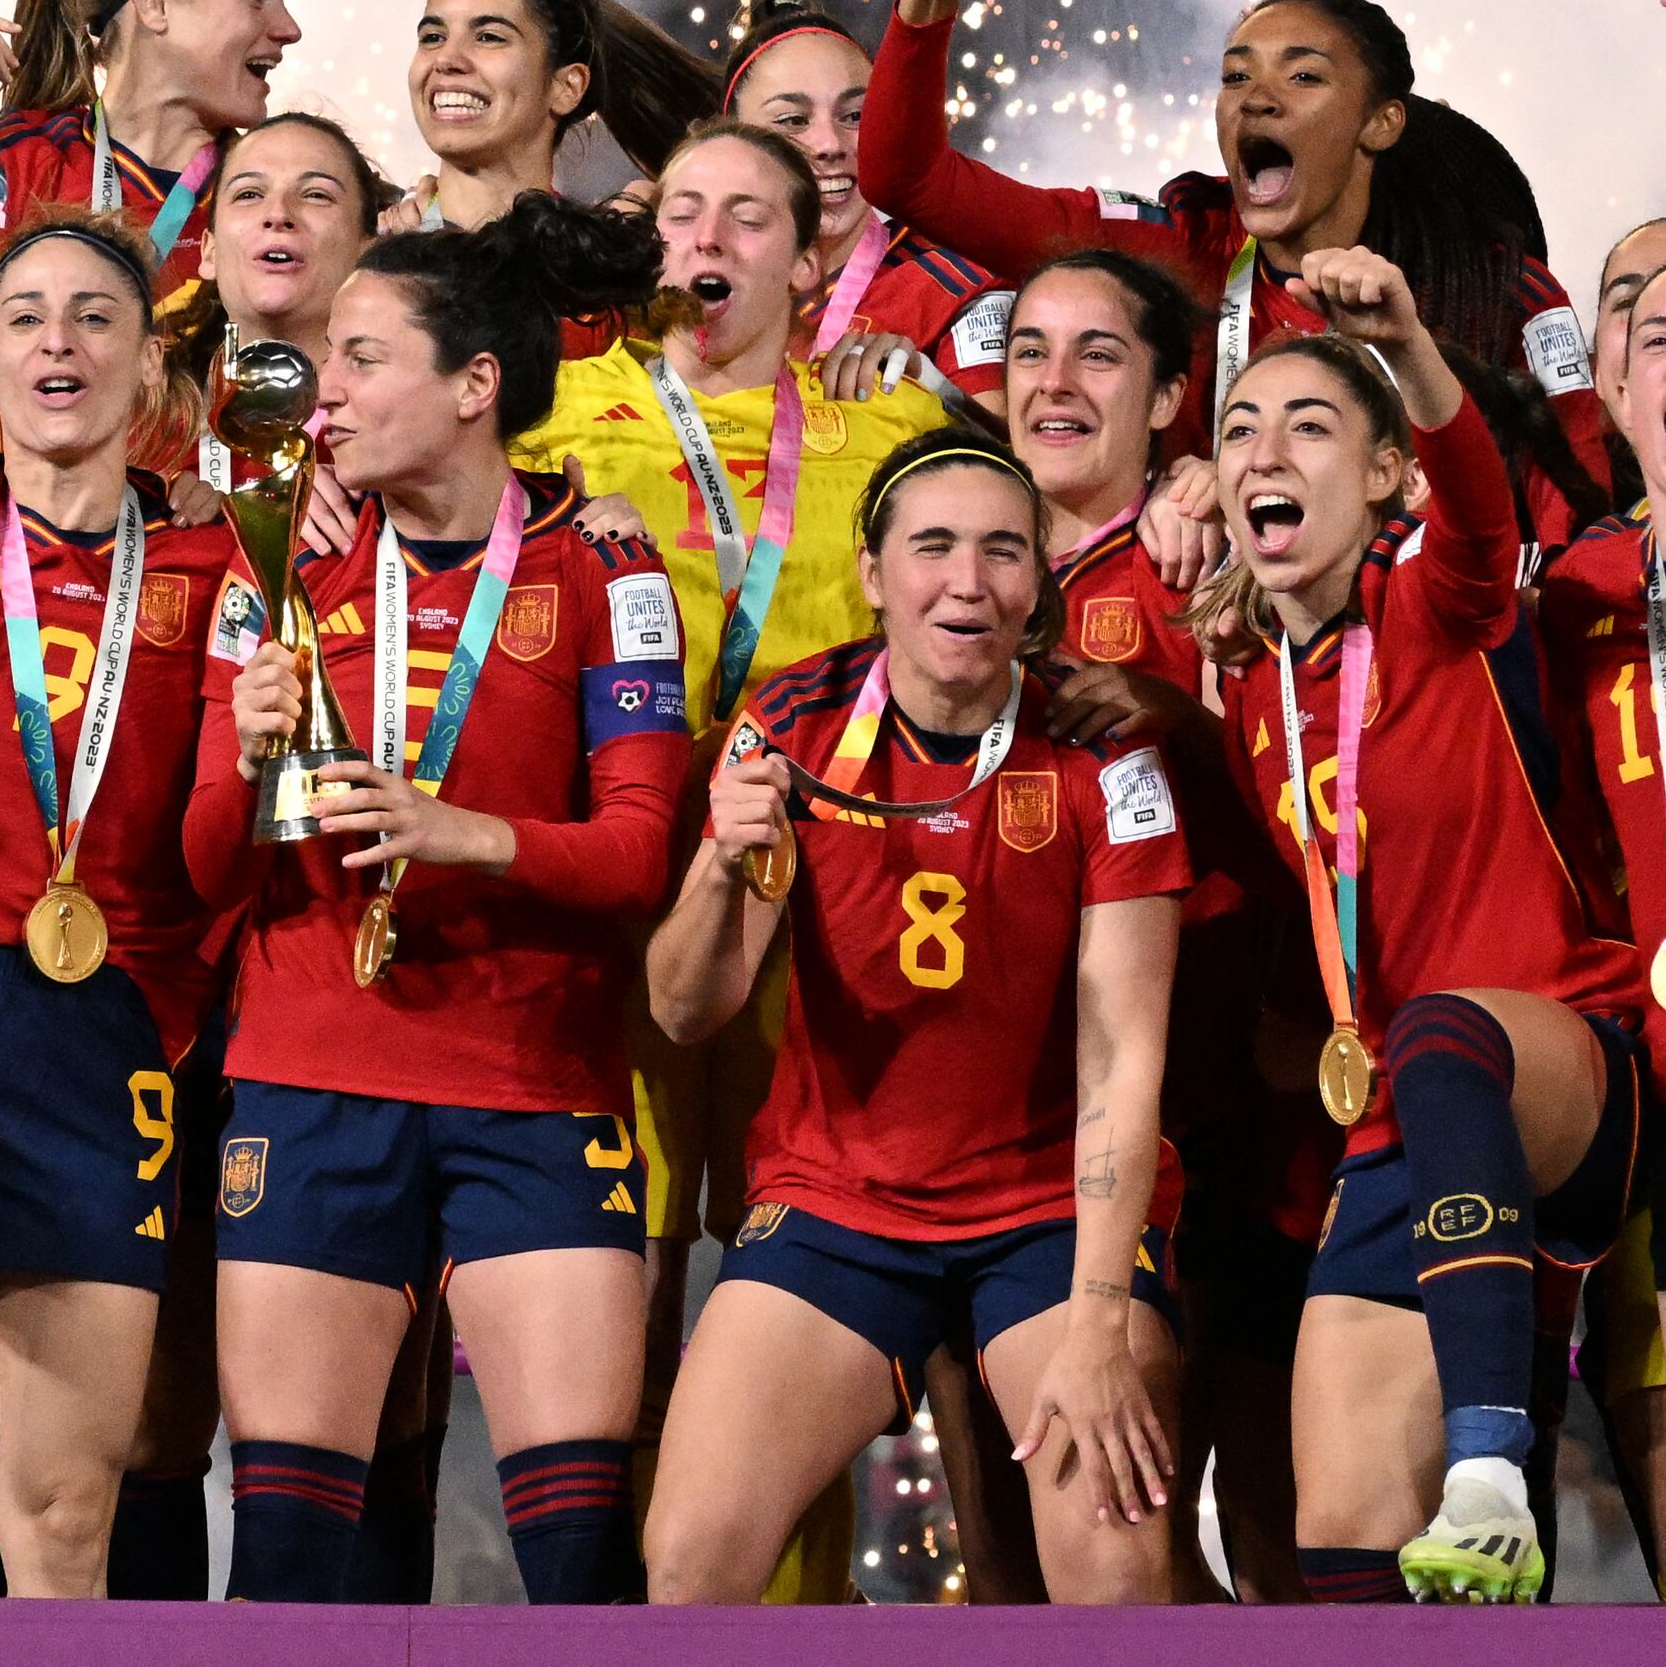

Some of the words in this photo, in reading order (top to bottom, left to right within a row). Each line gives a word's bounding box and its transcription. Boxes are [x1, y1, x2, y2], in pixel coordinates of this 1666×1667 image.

[966, 313, 1008, 331] UNITES
[1535, 321, 1573, 339] FOOTBALL
[982, 340, 1003, 350] FIFA
[1540, 332, 1576, 353] UNITES
[1542, 353, 1558, 367] the
[1558, 364, 1578, 377] FIFA
[668, 388, 692, 426] WORLD
[686, 427, 703, 452] CUP
[209, 458, 221, 488] CUP
[120, 527, 137, 590] WOMEN'S
[385, 561, 396, 591] FIFA
[65, 582, 95, 593] ENGLAND
[624, 588, 662, 602] FOOTBALL
[113, 591, 130, 640] WORLD
[418, 607, 448, 615] ENGLAND
[626, 600, 665, 617] UNITES
[385, 592, 397, 657] WOMEN'S
[416, 614, 441, 623] AUGUST
[442, 616, 459, 625] 2023
[420, 622, 445, 630] SYDNEY
[625, 618, 643, 631] the
[644, 615, 669, 631] World
[641, 633, 661, 644] FIFA
[107, 641, 121, 670] CUP
[384, 659, 396, 710] WORLD
[655, 696, 671, 706] JOY
[655, 705, 676, 715] LOVE
[383, 711, 396, 741] CUP
[989, 717, 1006, 748] FIFA
[1116, 764, 1155, 786] FOOTBALL
[1121, 774, 1158, 797] UNITES
[1120, 798, 1136, 811] the
[1138, 790, 1162, 808] World
[952, 819, 969, 829] 2023
[1136, 811, 1154, 822] FIFA
[929, 825, 955, 834] SYDNEY
[899, 871, 967, 989] 8
[128, 1070, 174, 1181] 9
[1498, 1206, 1519, 1223] 09
